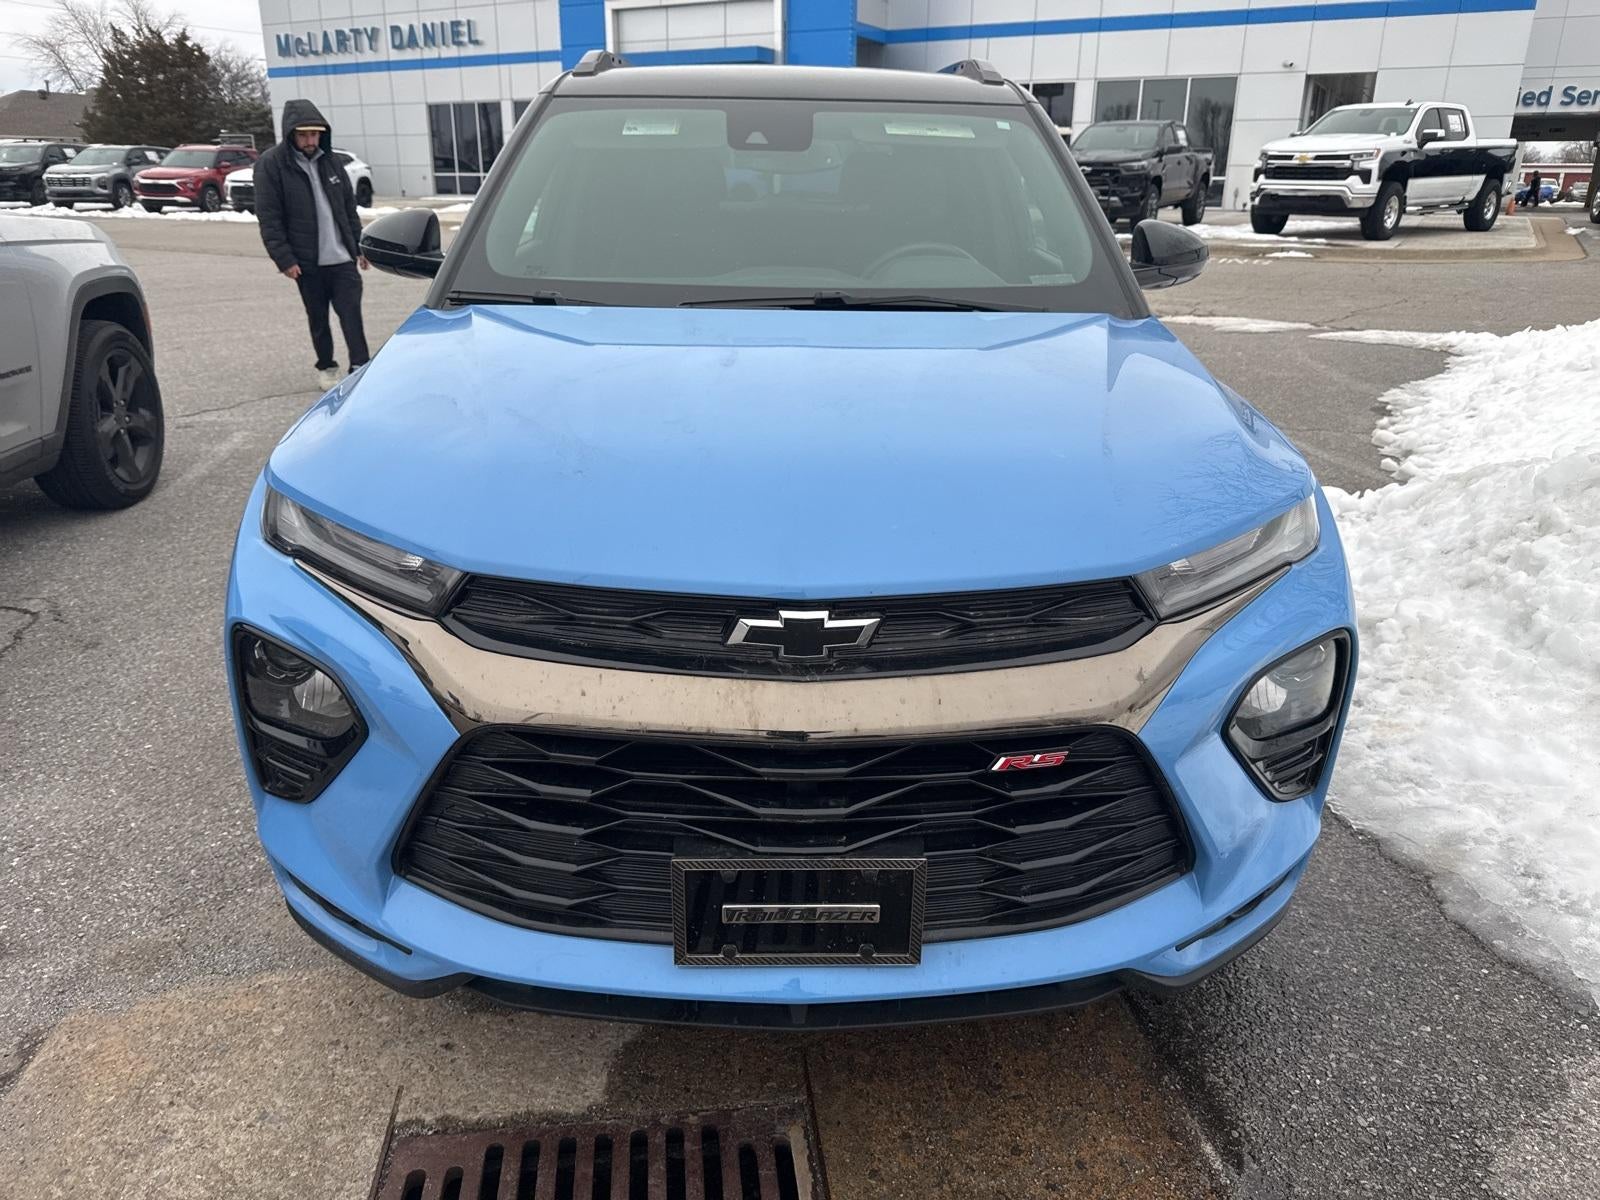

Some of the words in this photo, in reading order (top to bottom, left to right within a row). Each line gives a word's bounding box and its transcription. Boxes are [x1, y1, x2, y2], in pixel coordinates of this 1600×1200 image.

[276, 26, 379, 57] McLARTY
[390, 19, 481, 50] DANIEL
[991, 751, 1069, 772] RS
